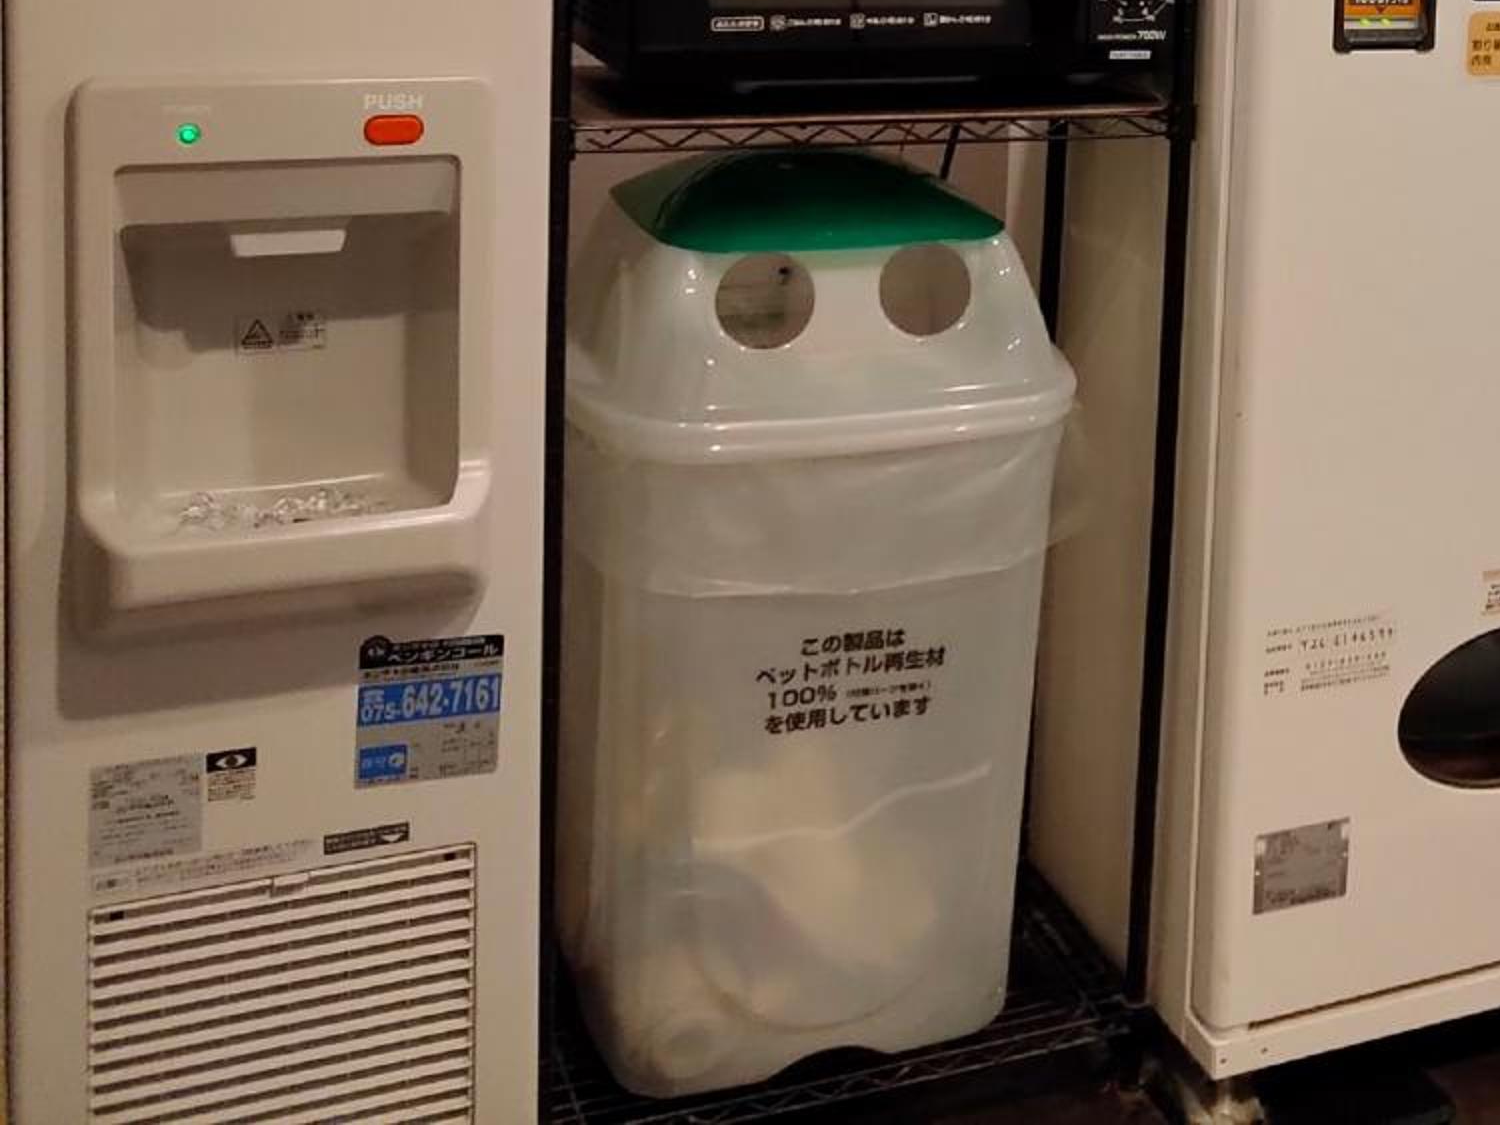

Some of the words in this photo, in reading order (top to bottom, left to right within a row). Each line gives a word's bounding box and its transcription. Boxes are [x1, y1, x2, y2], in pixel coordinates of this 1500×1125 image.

[363, 93, 423, 110] PUSH
[800, 629, 906, 657] この製品は
[755, 645, 947, 686] ペットボトル再生材
[767, 684, 838, 710] 100%
[763, 695, 931, 735] を使用しています
